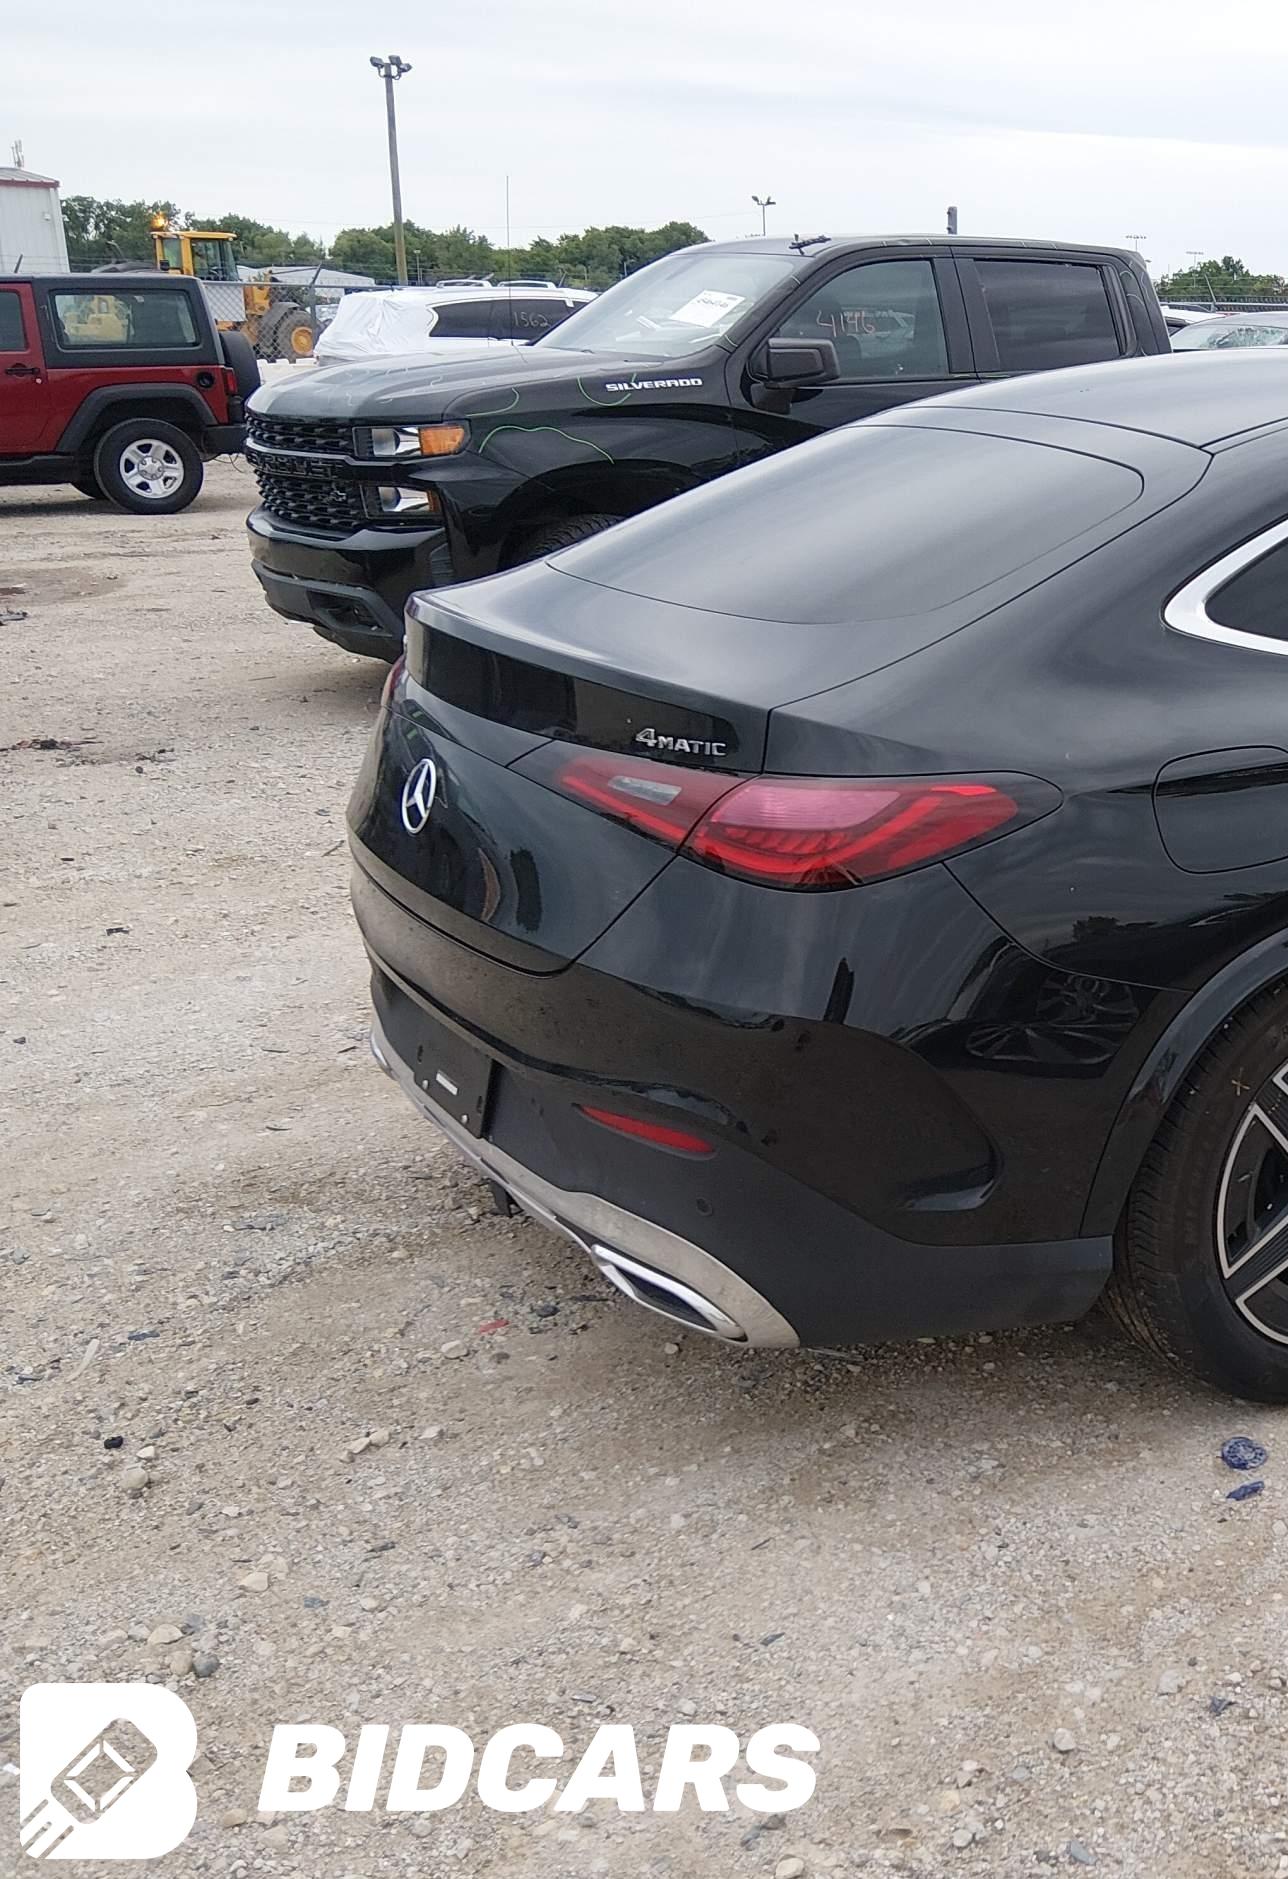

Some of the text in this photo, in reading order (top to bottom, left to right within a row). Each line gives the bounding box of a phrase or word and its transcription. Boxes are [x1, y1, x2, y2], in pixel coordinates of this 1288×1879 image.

[816, 309, 876, 338] 4146
[605, 378, 703, 392] SILVERADO
[635, 727, 727, 756] 4MATIC
